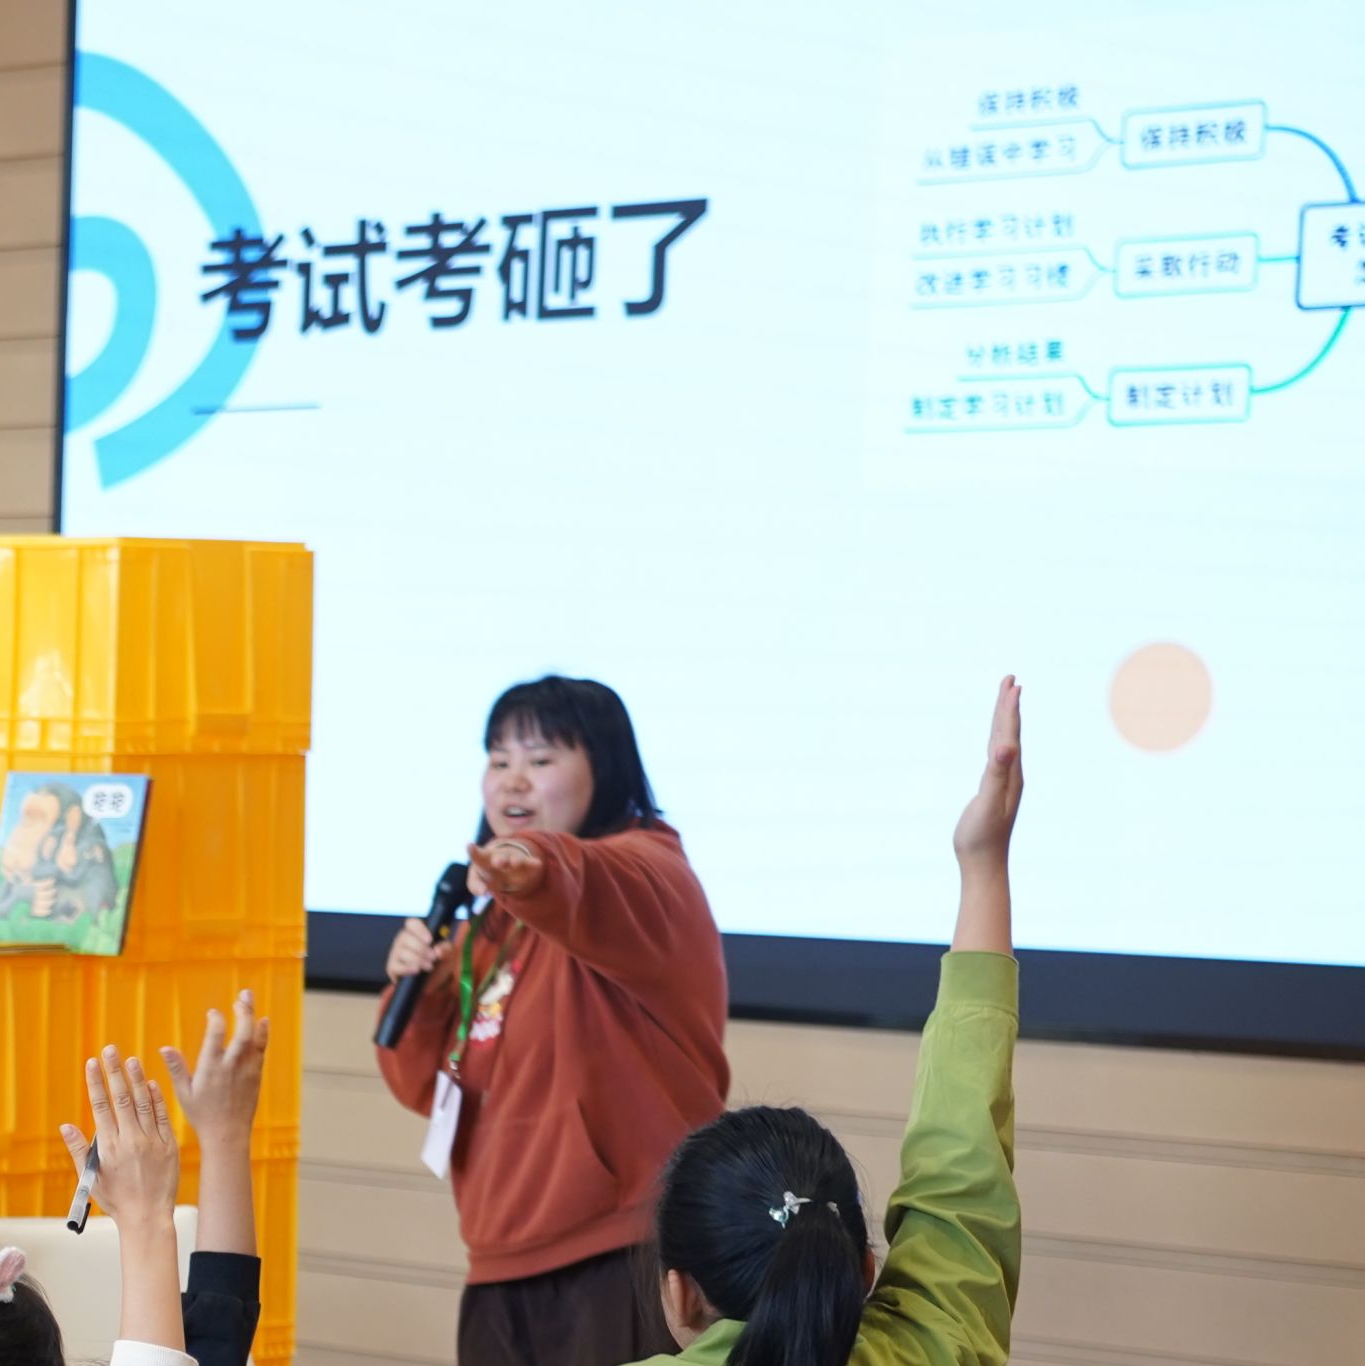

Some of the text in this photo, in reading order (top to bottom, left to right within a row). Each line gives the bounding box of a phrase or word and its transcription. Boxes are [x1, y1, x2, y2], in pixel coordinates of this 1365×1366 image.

[200, 197, 709, 342] 考试考砸了
[1126, 382, 1234, 410] 制定计划
